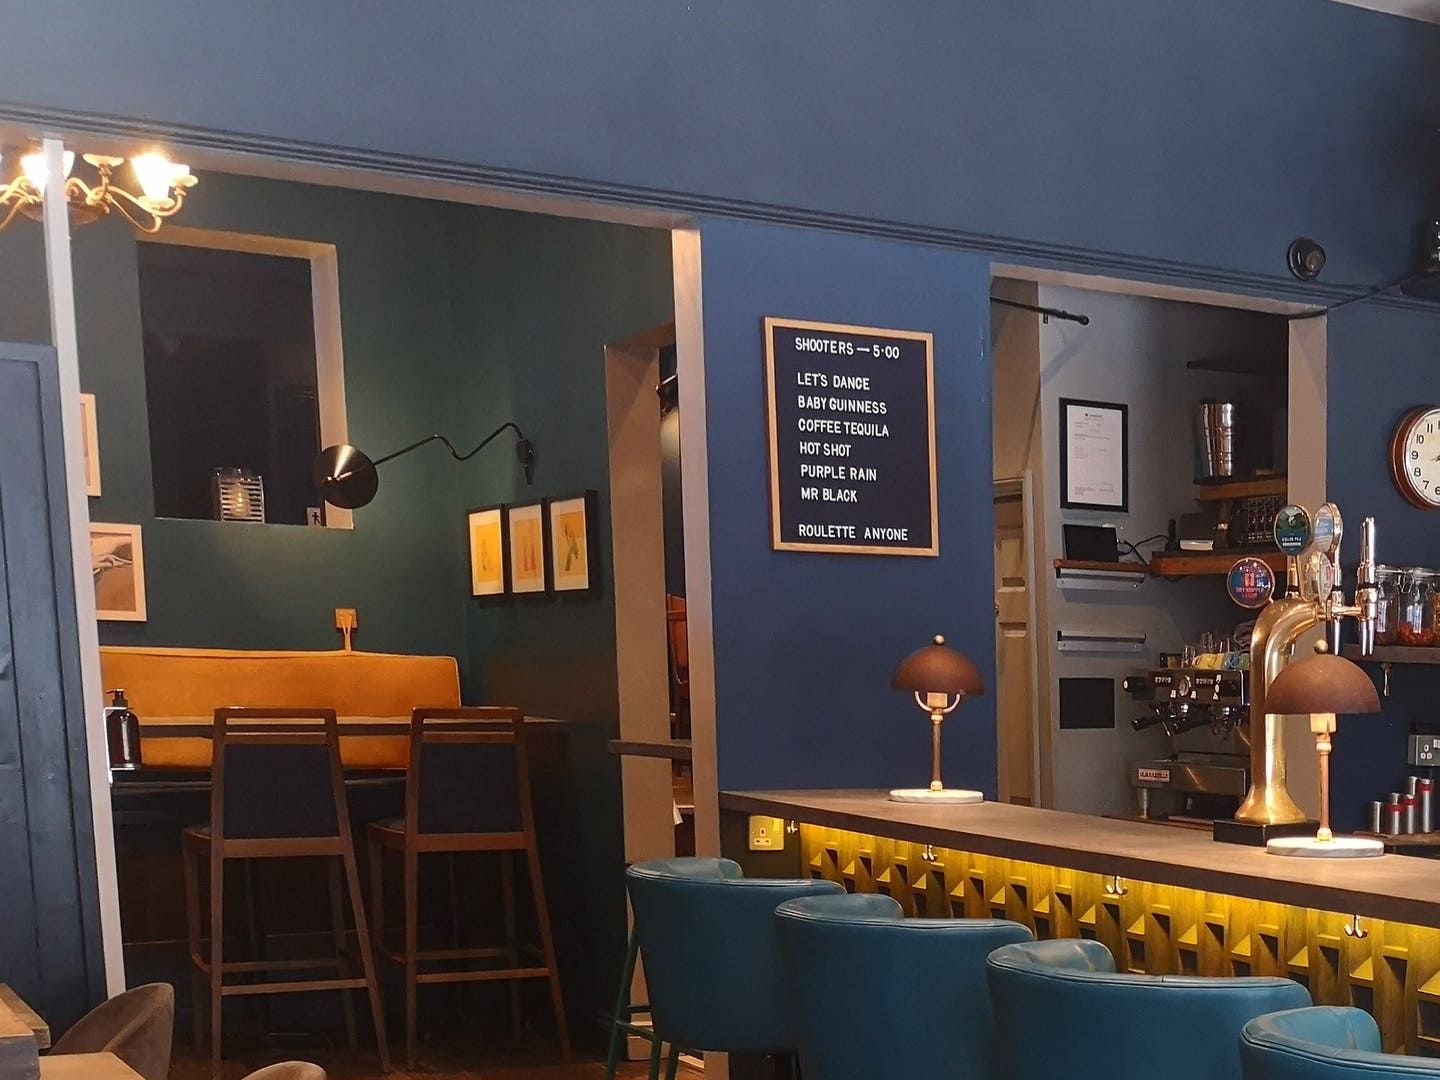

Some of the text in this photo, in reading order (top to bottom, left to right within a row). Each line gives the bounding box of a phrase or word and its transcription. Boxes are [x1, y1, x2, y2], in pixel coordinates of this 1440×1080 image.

[795, 336, 854, 356] SHOOTERS
[797, 371, 871, 391] LET'S DANCE
[797, 394, 887, 415] BABY GUINNESS
[797, 417, 890, 437] COFFEE TEQUILA
[1426, 423, 1433, 433] 11
[1416, 434, 1424, 445] 10
[799, 441, 852, 458] HOT SHOT
[1411, 450, 1418, 460] 9
[800, 463, 877, 482] PURPLE RAIN
[1414, 467, 1421, 477] 8
[1422, 480, 1429, 490] 7
[800, 486, 858, 503] MR BLACK
[798, 523, 909, 541] ROULETTE ANYONE
